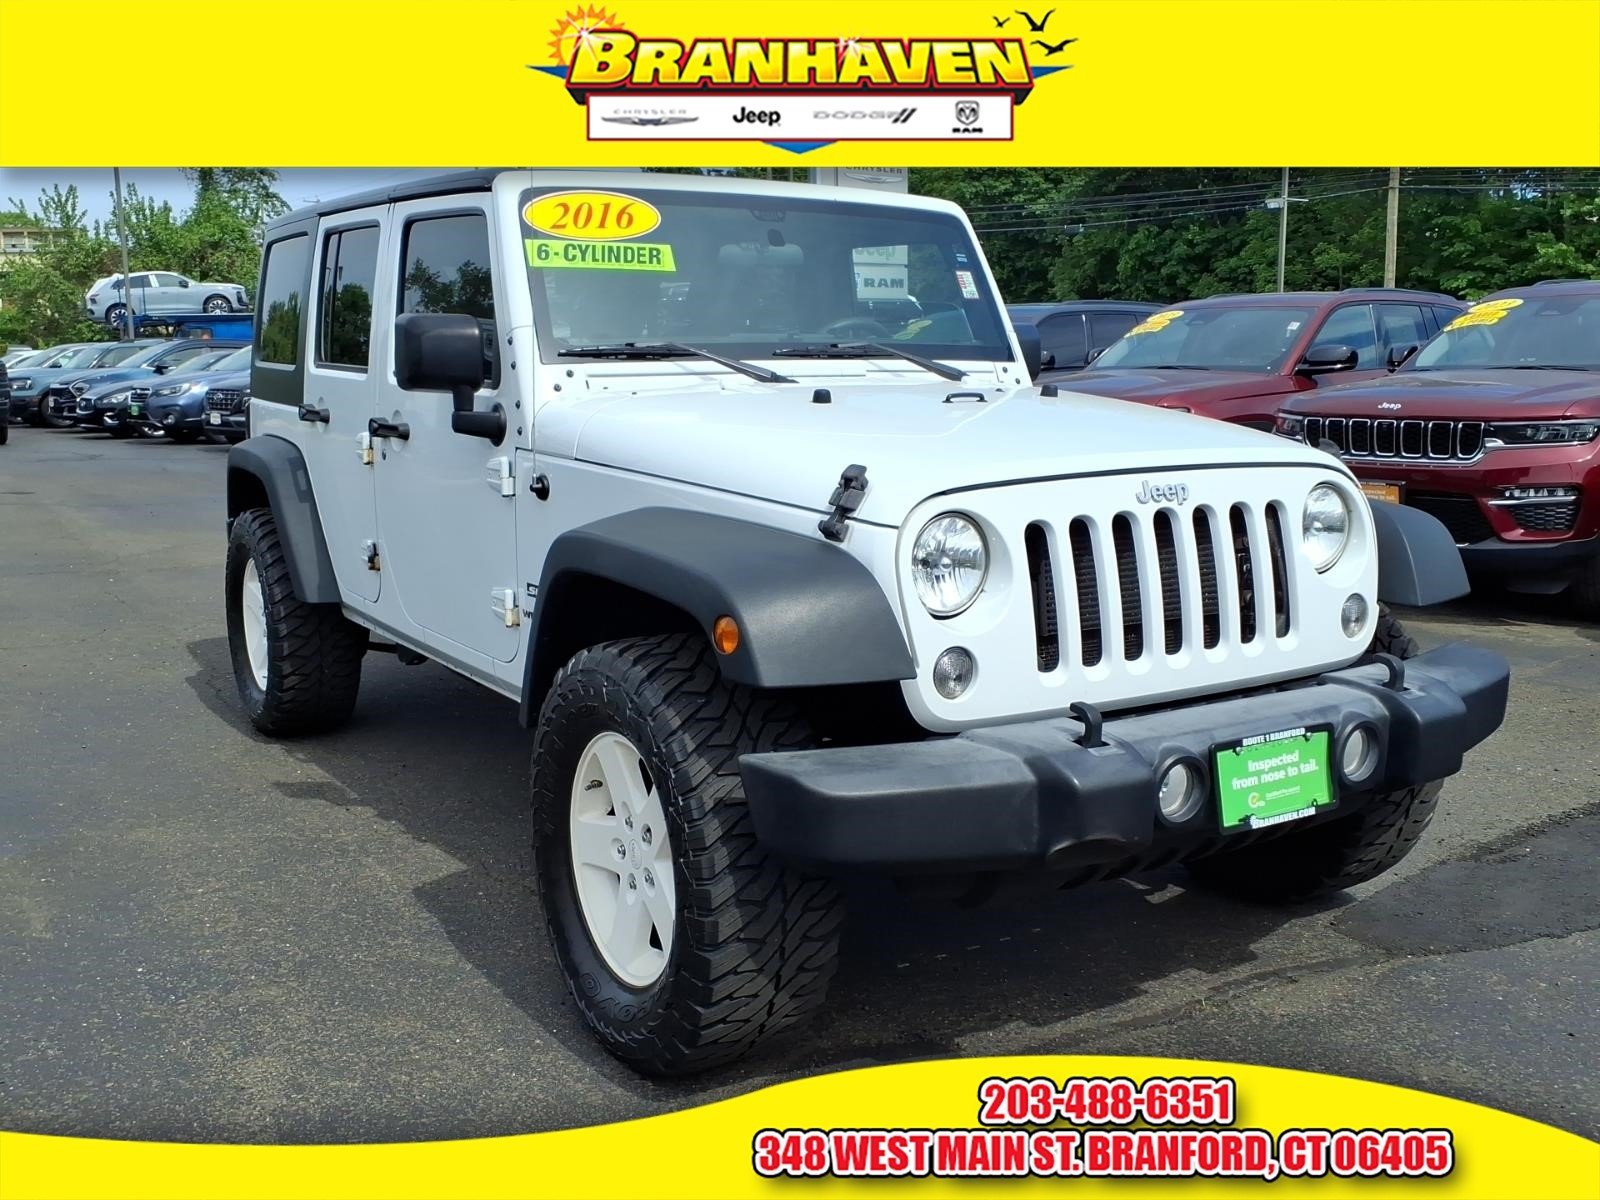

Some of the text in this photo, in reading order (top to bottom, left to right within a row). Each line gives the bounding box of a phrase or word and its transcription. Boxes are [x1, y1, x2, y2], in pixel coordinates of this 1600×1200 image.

[846, 166, 902, 174] YSLER
[550, 202, 636, 230] 2016
[863, 277, 905, 288] RAM
[1135, 479, 1190, 506] Jeep
[1242, 735, 1266, 747] ROUTE
[1247, 749, 1300, 772] Inspected
[1231, 776, 1259, 790] from
[1260, 770, 1286, 784] nose
[1287, 765, 1299, 777] to
